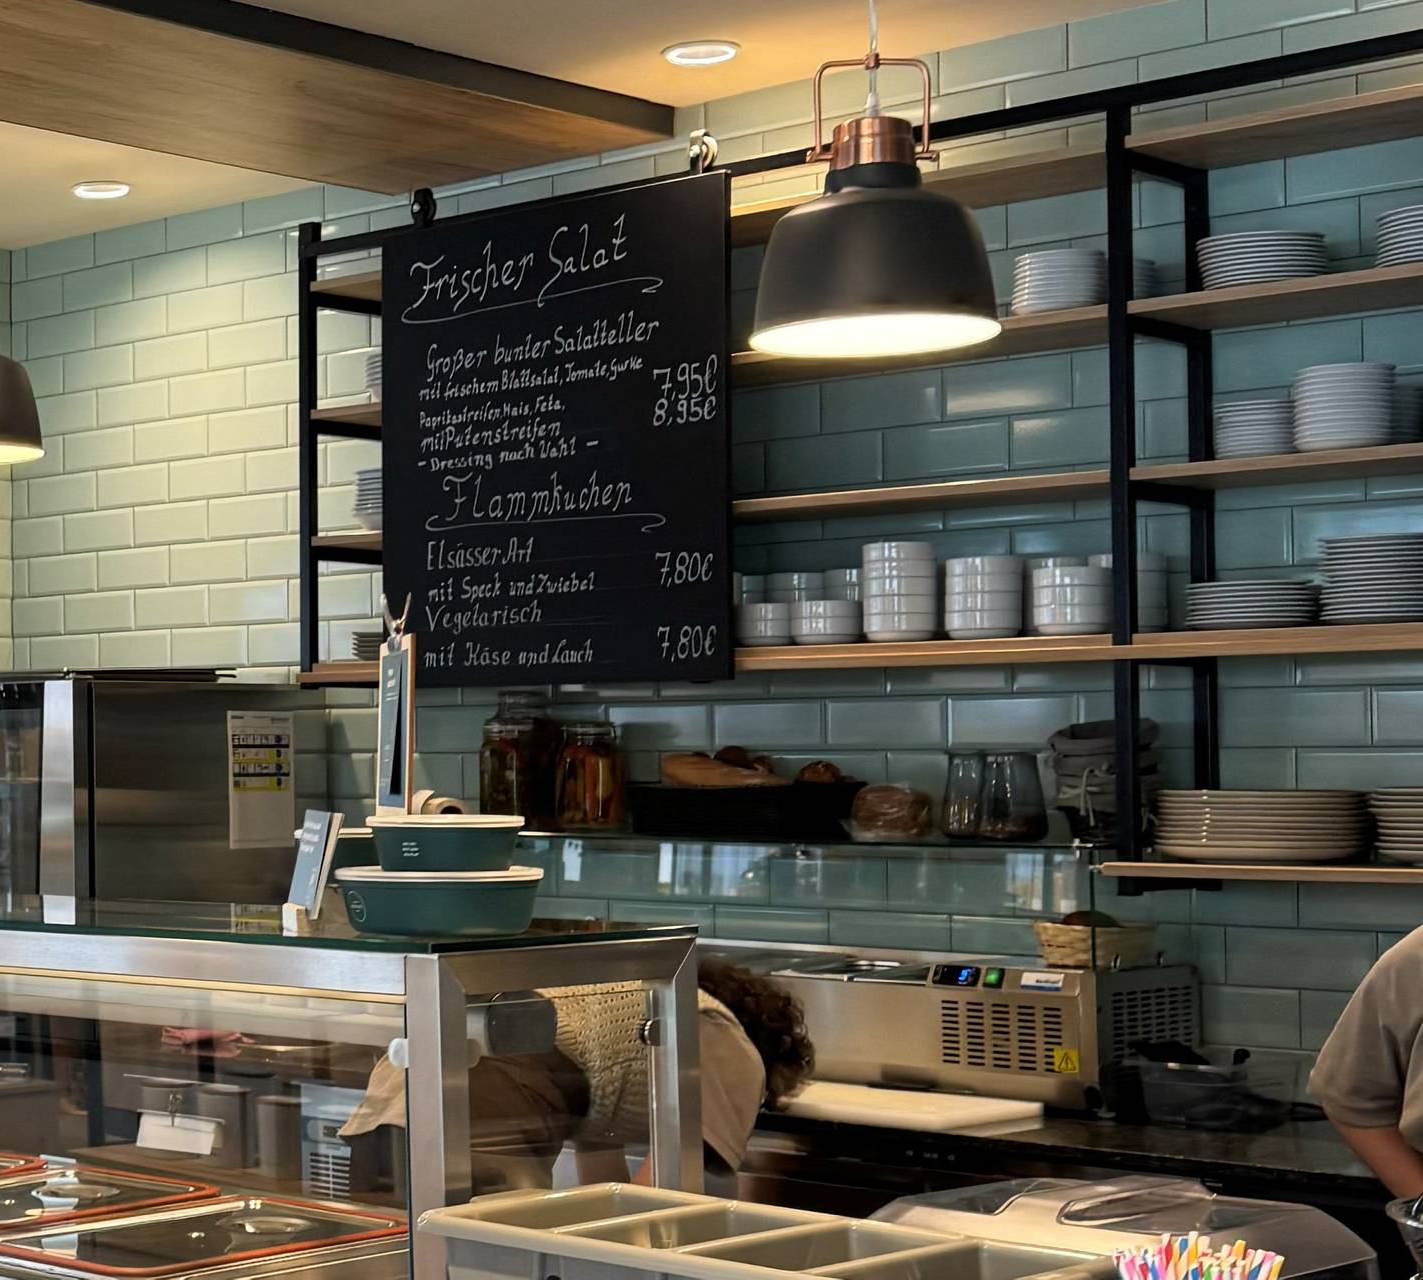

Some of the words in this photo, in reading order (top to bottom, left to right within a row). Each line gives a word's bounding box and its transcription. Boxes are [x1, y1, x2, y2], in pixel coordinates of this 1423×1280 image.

[410, 240, 534, 312] Frischer
[538, 212, 627, 307] Salat
[427, 343, 487, 382] Großer
[554, 310, 660, 355] Salatteller
[444, 378, 498, 398] frischem
[653, 354, 718, 401] 7,95€
[652, 397, 717, 426] 8,95€
[430, 451, 493, 472] Dressing
[499, 441, 535, 463] nach
[539, 436, 576, 459] Wahl
[443, 470, 632, 521] Flammkuchen
[428, 580, 453, 602] mit
[462, 572, 501, 602] Speck
[655, 551, 714, 588] 7,80€
[426, 600, 542, 634] Vegetarisch
[424, 642, 455, 667] mit
[464, 641, 510, 667] Käse
[657, 625, 717, 662] 7,80€
